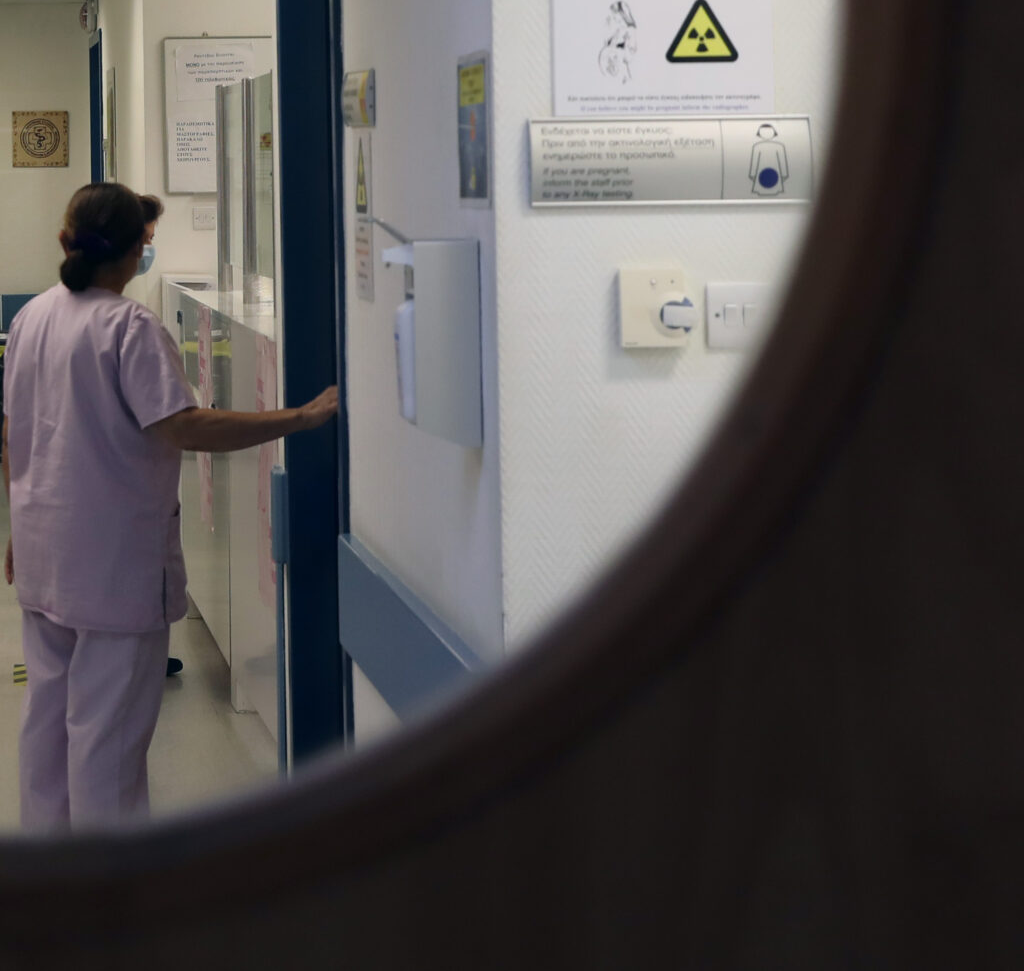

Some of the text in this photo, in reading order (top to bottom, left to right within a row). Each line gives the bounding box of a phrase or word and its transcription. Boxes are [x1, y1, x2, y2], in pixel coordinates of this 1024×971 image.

[551, 168, 569, 177] you
[573, 179, 589, 187] the
[590, 179, 611, 187] staff
[612, 179, 634, 189] prior
[542, 191, 551, 199] to
[553, 192, 570, 200] any
